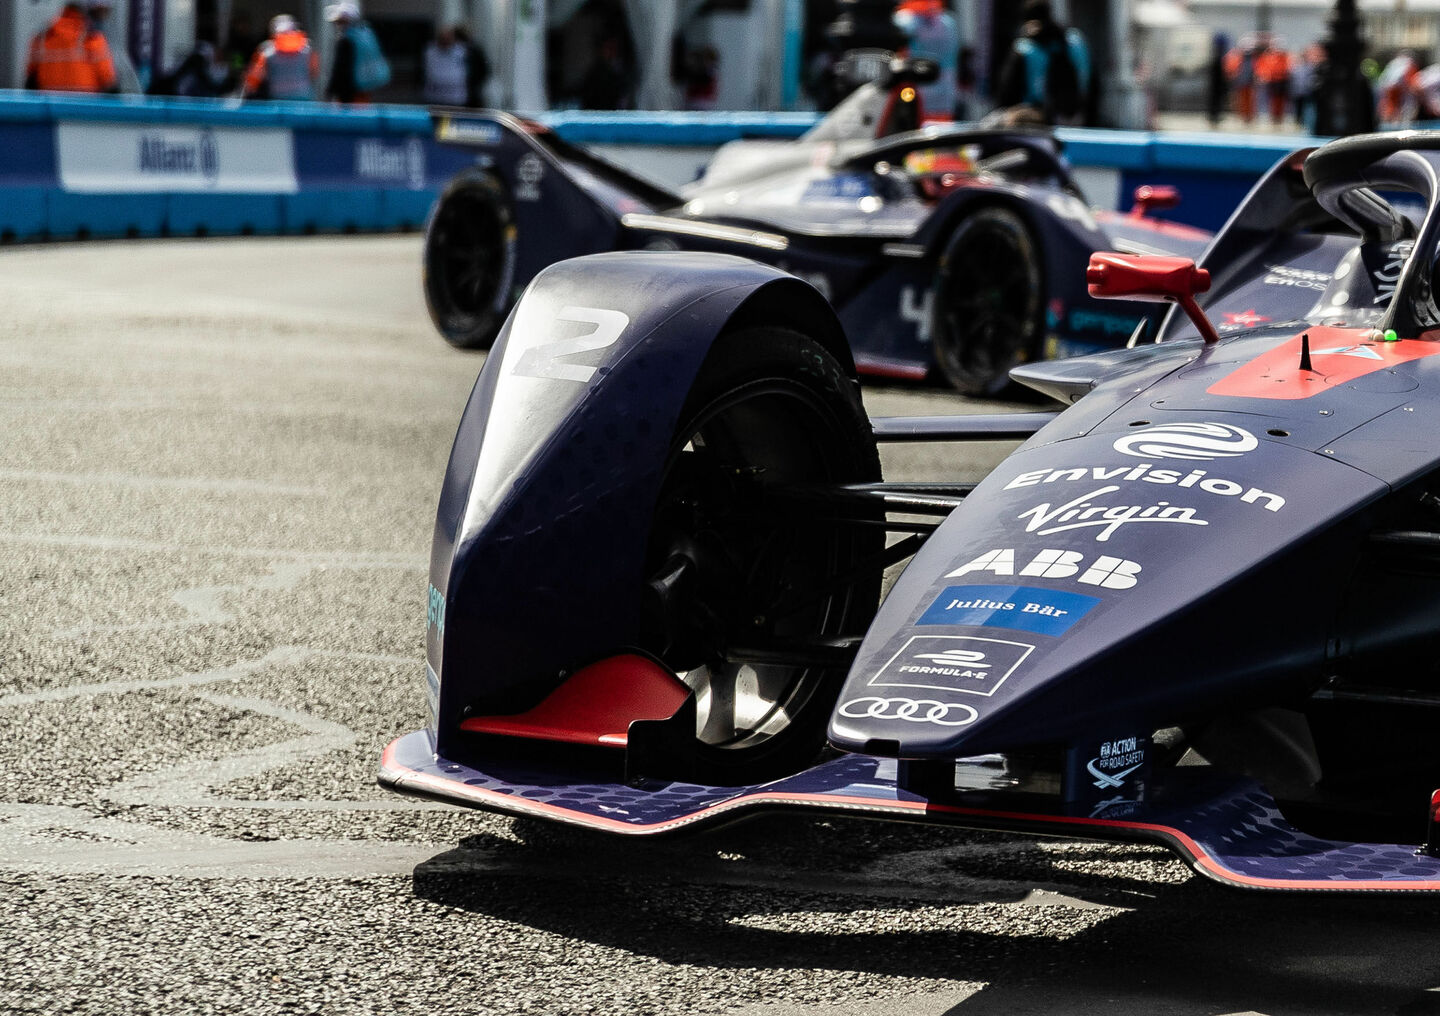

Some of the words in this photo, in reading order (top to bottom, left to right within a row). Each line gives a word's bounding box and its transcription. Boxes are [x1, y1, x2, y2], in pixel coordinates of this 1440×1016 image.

[510, 306, 630, 383] 2
[1002, 462, 1286, 513] Envision
[1017, 485, 1209, 542] Virgin
[943, 548, 1143, 590] ABB
[945, 596, 1015, 612] Julius
[1021, 600, 1068, 619] Bär
[1109, 754, 1125, 769] ROAD
[1125, 750, 1144, 765] SAFETY
[1112, 736, 1137, 756] ACTION
